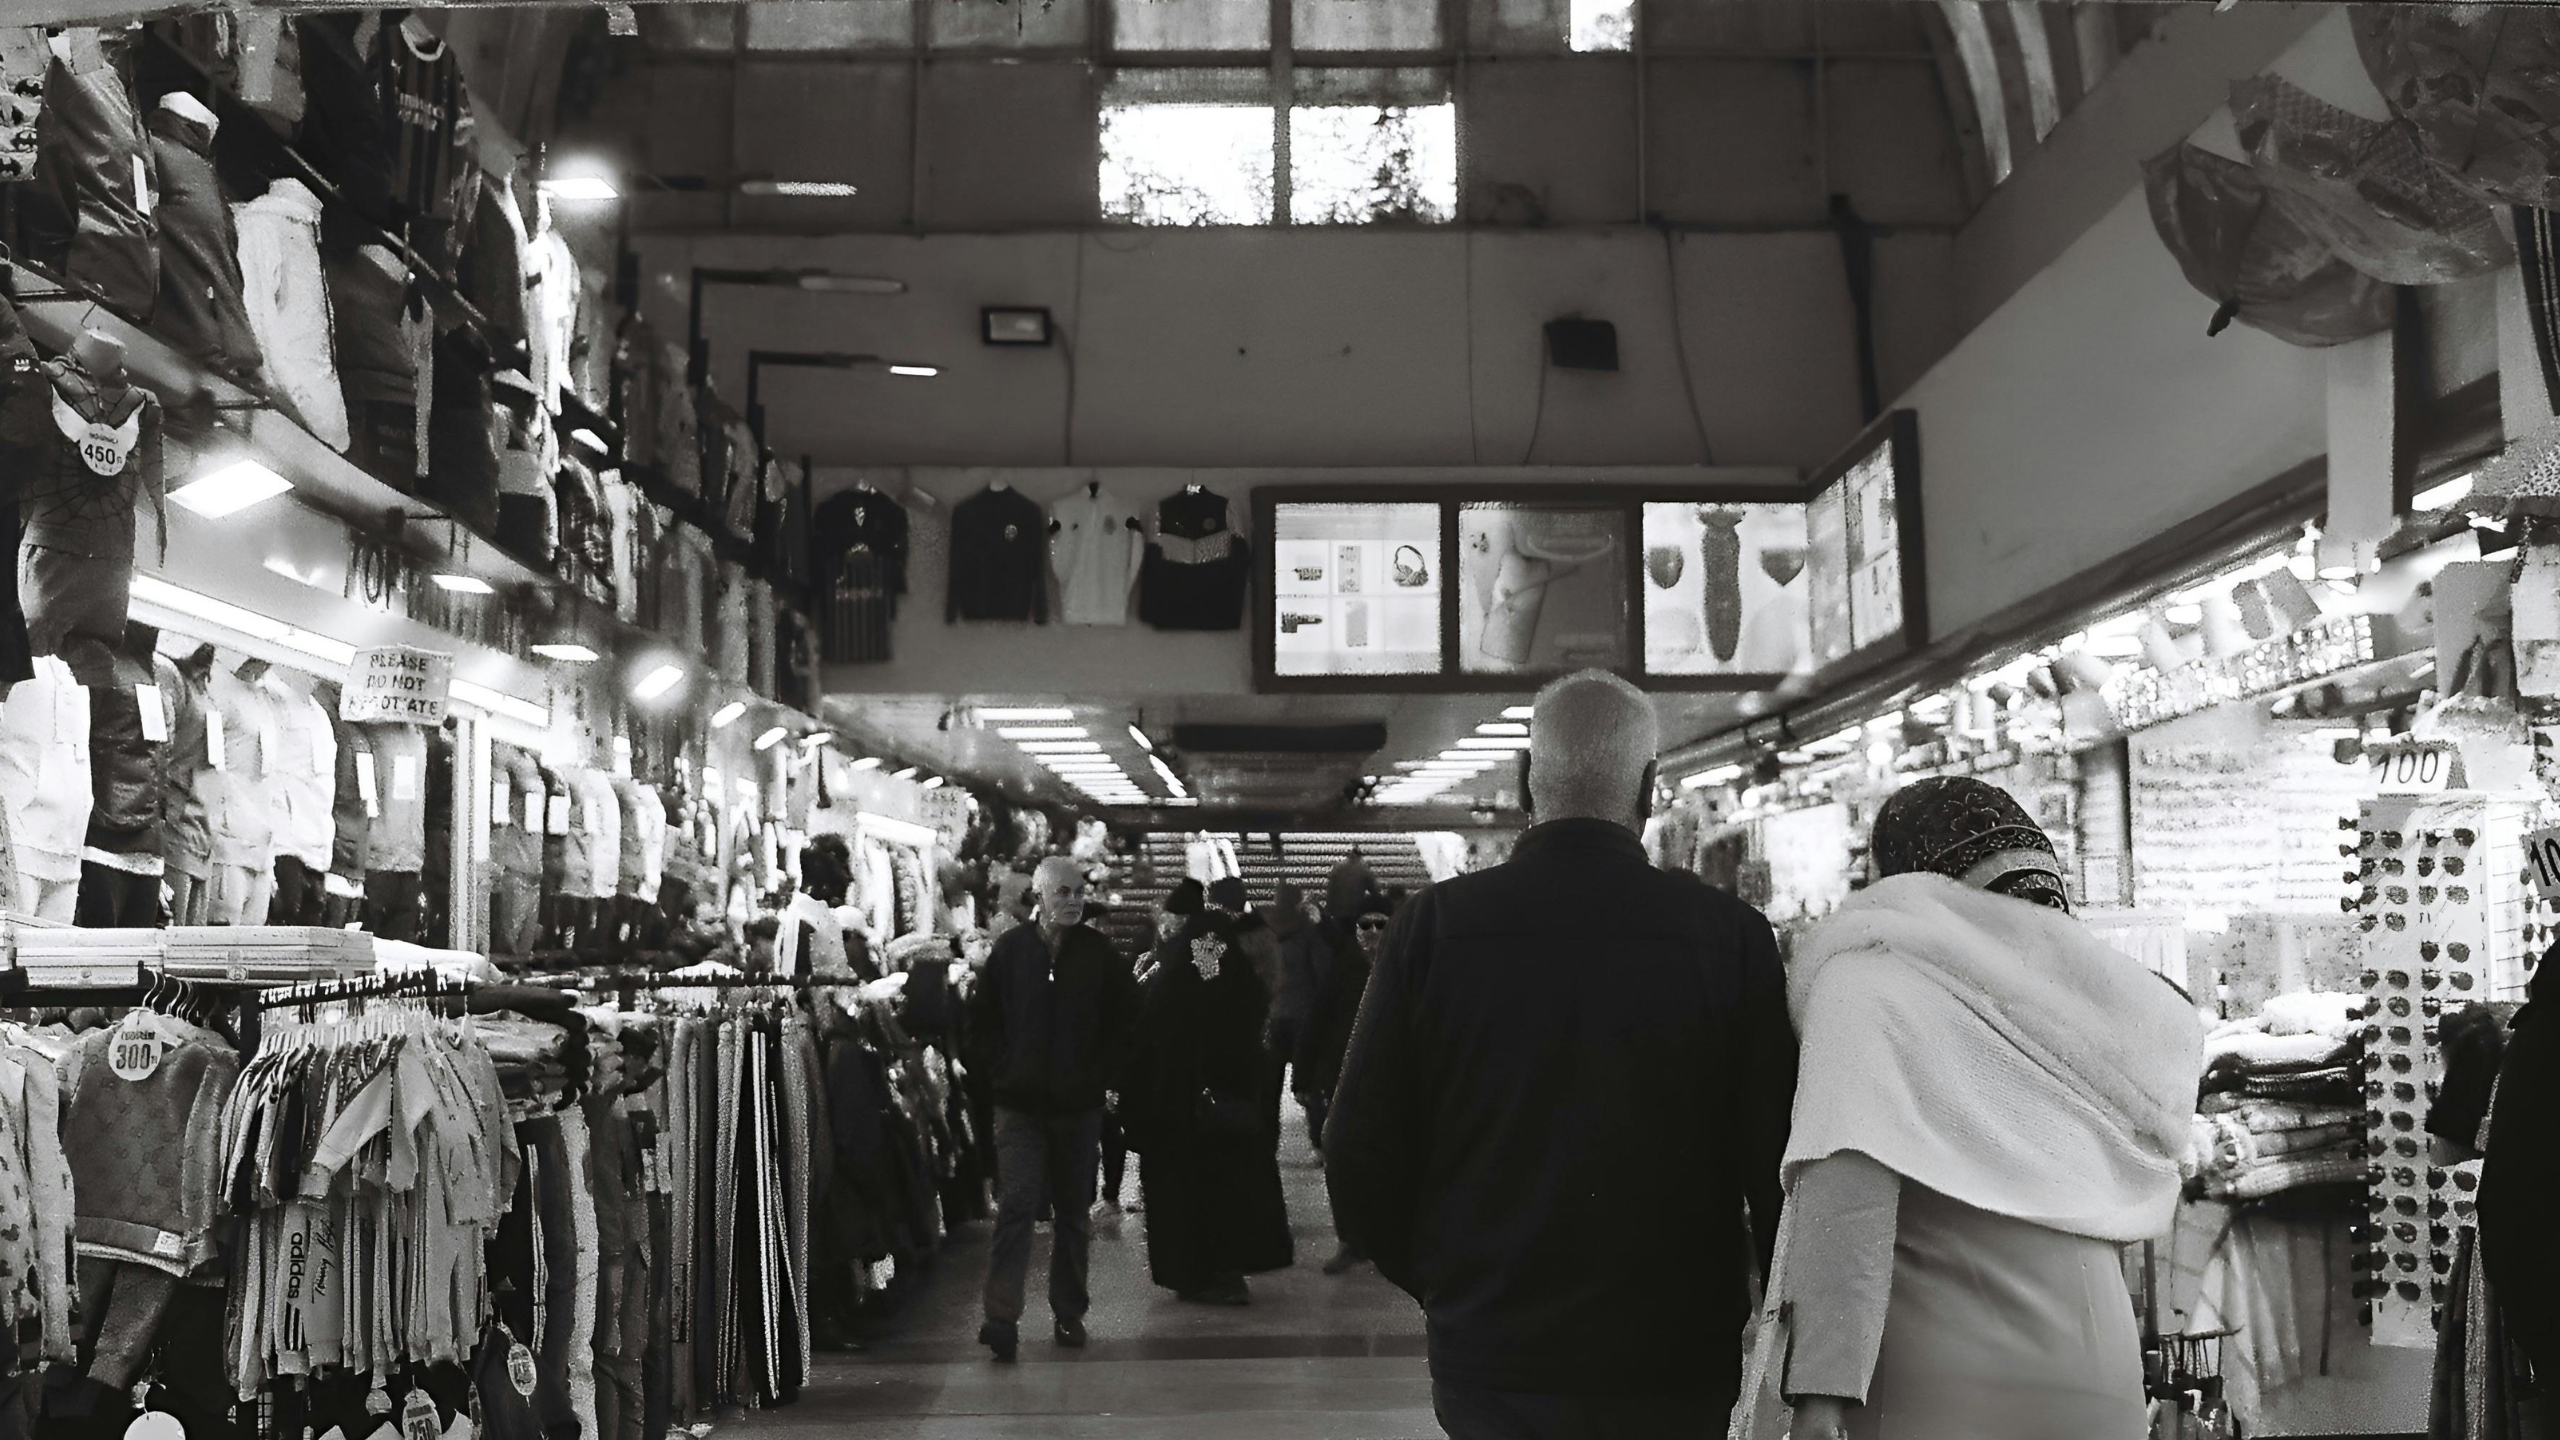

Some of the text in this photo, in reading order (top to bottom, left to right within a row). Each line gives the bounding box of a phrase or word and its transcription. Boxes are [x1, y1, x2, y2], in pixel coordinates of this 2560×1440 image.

[84, 444, 116, 465] 450
[370, 653, 427, 672] PLEASE
[366, 675, 426, 691] DO NOT
[348, 695, 438, 716] NOTATE
[2375, 750, 2439, 784] 100
[116, 1043, 151, 1070] 300
[287, 1232, 305, 1299] adidas
